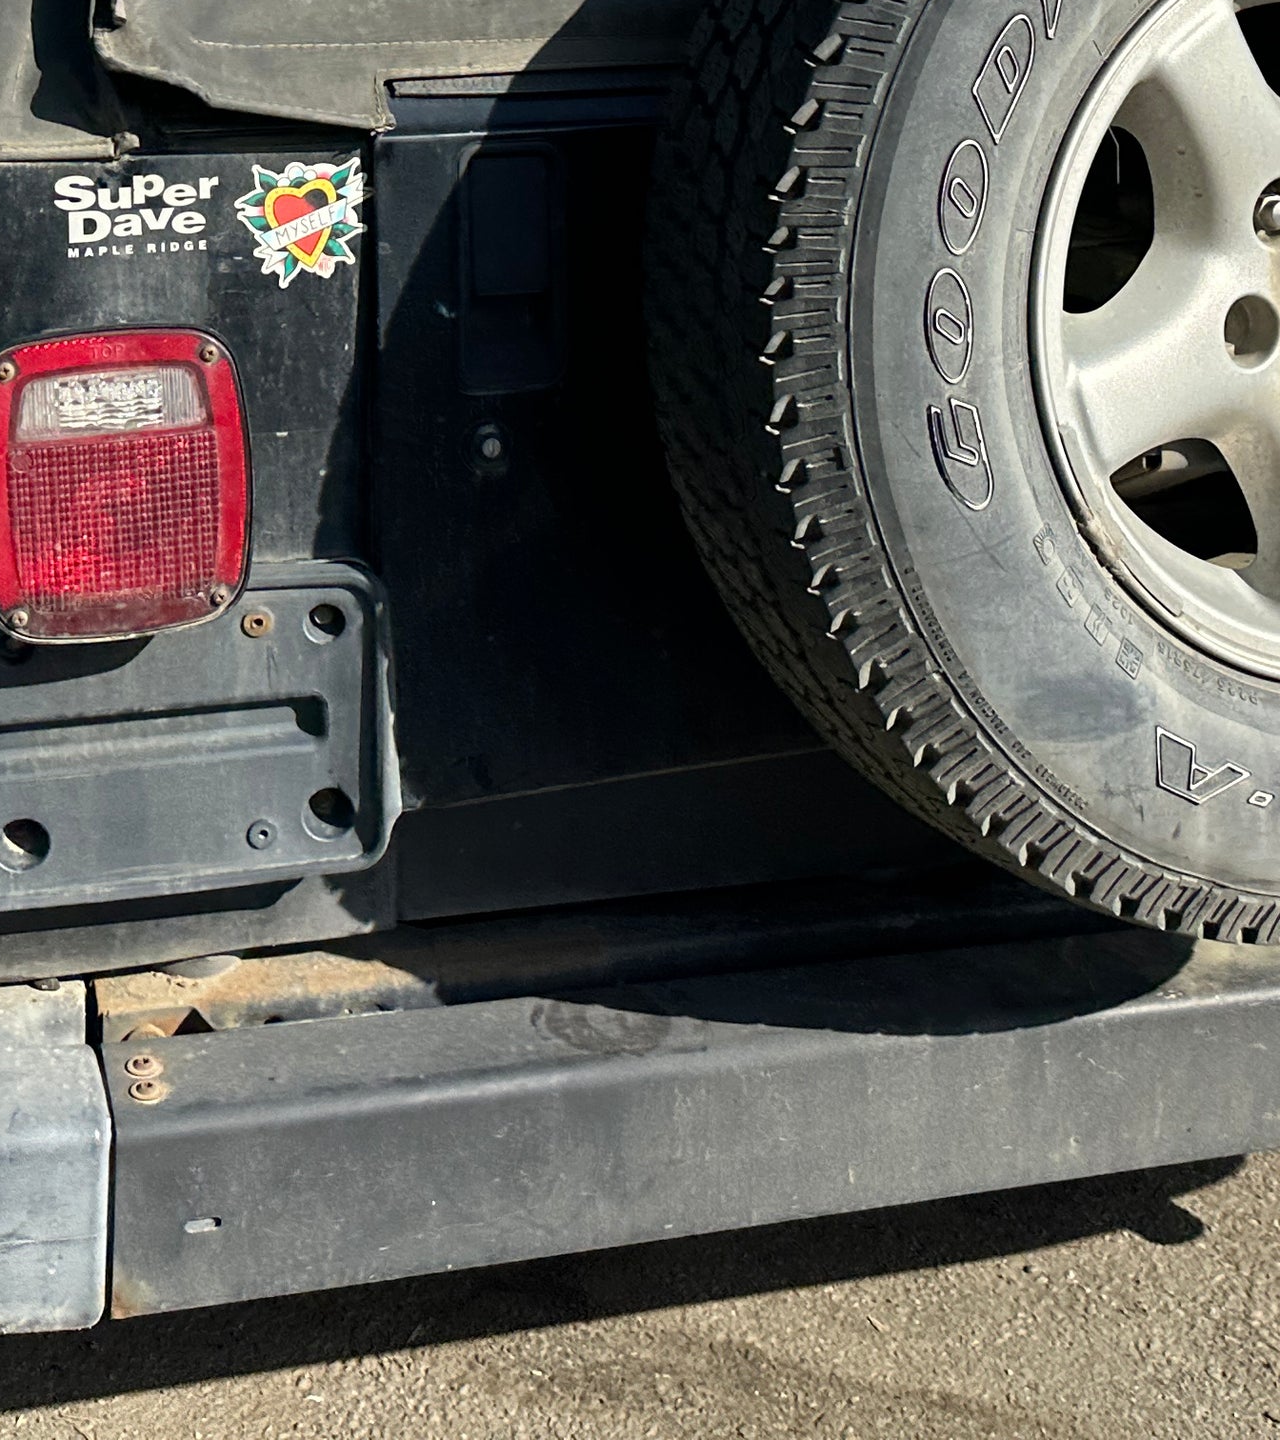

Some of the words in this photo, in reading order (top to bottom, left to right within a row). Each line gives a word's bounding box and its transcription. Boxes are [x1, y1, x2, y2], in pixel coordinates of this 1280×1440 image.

[274, 205, 338, 247] MYSELF
[67, 244, 134, 258] MAPLE
[147, 240, 207, 254] RIDGE
[88, 342, 125, 359] TOP
